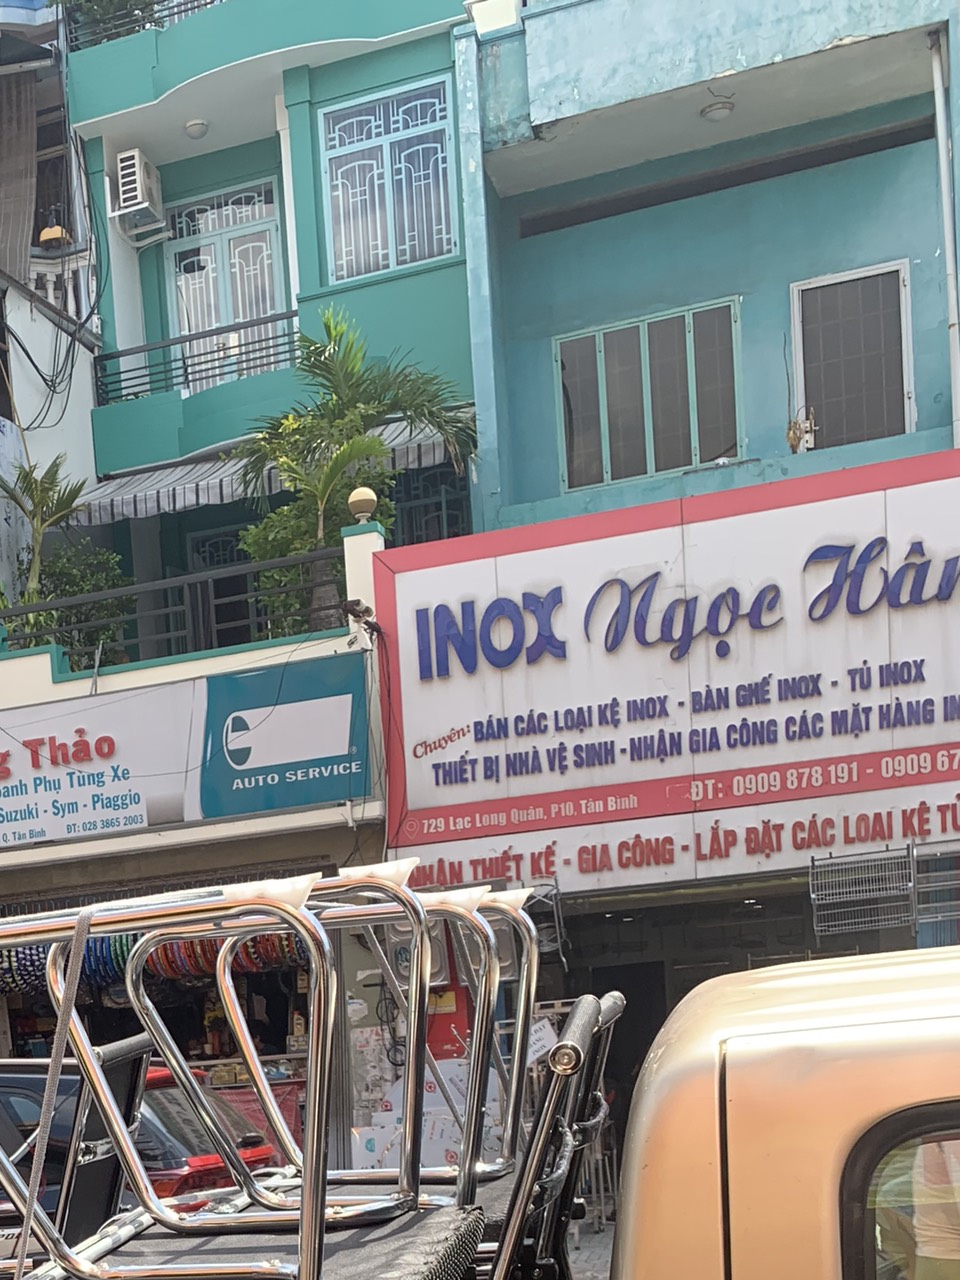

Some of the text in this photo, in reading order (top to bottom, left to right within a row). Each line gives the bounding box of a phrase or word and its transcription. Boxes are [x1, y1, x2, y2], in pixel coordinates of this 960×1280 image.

[415, 586, 567, 681] INOX
[583, 571, 784, 661] Ngọc
[413, 724, 471, 759] Chuyên:
[473, 714, 509, 742] BÁN
[514, 709, 548, 737] CÁC
[554, 705, 593, 733] LOẠI
[598, 697, 620, 728] KỆ
[627, 695, 669, 722] INOX
[692, 685, 730, 714] BÀN
[735, 674, 773, 707] GHẾ
[777, 673, 822, 701] INOX
[847, 659, 872, 692] TỦ
[878, 658, 926, 688] INOX
[22, 727, 117, 770] Thảo
[432, 750, 478, 787] THIẾT
[484, 755, 500, 783] BỊ
[505, 746, 542, 777] NHÀ
[546, 742, 568, 775] VỆ
[573, 740, 615, 769] SINH
[629, 728, 682, 763] NHẬN
[690, 727, 721, 752] GIA
[726, 718, 778, 749] CÔNG
[785, 710, 824, 741] CÁC
[831, 703, 872, 738] MẶT
[878, 697, 935, 730] HÀNG
[33, 775, 61, 794] Phụ
[66, 768, 105, 788] Tùng
[111, 764, 130, 782] Xe
[232, 761, 362, 790] AUTO SERVICE
[690, 779, 723, 801] ĐT:
[732, 771, 781, 797] 0909
[786, 766, 823, 790] 878
[827, 762, 858, 784] 191
[881, 752, 932, 778] 0909
[52, 799, 78, 818] Sym
[91, 789, 141, 811] Piaggio
[66, 814, 144, 834] ĐT: 028 3865 2003
[422, 818, 445, 834] 729
[449, 816, 472, 833] Lạc
[475, 811, 507, 829] Long
[510, 806, 547, 823] Quân,
[580, 799, 604, 815] Tân
[607, 794, 638, 811] Bình
[2, 833, 10, 843] Q.
[12, 830, 27, 841] Tân
[29, 828, 46, 839] Bình
[469, 845, 523, 882] THIẾT
[530, 840, 557, 878] KẾ
[577, 843, 613, 874] GIA
[617, 834, 674, 868] CÔNG
[695, 819, 737, 861] LẮP
[745, 819, 784, 858] ĐẶT
[792, 813, 836, 850] CÁC
